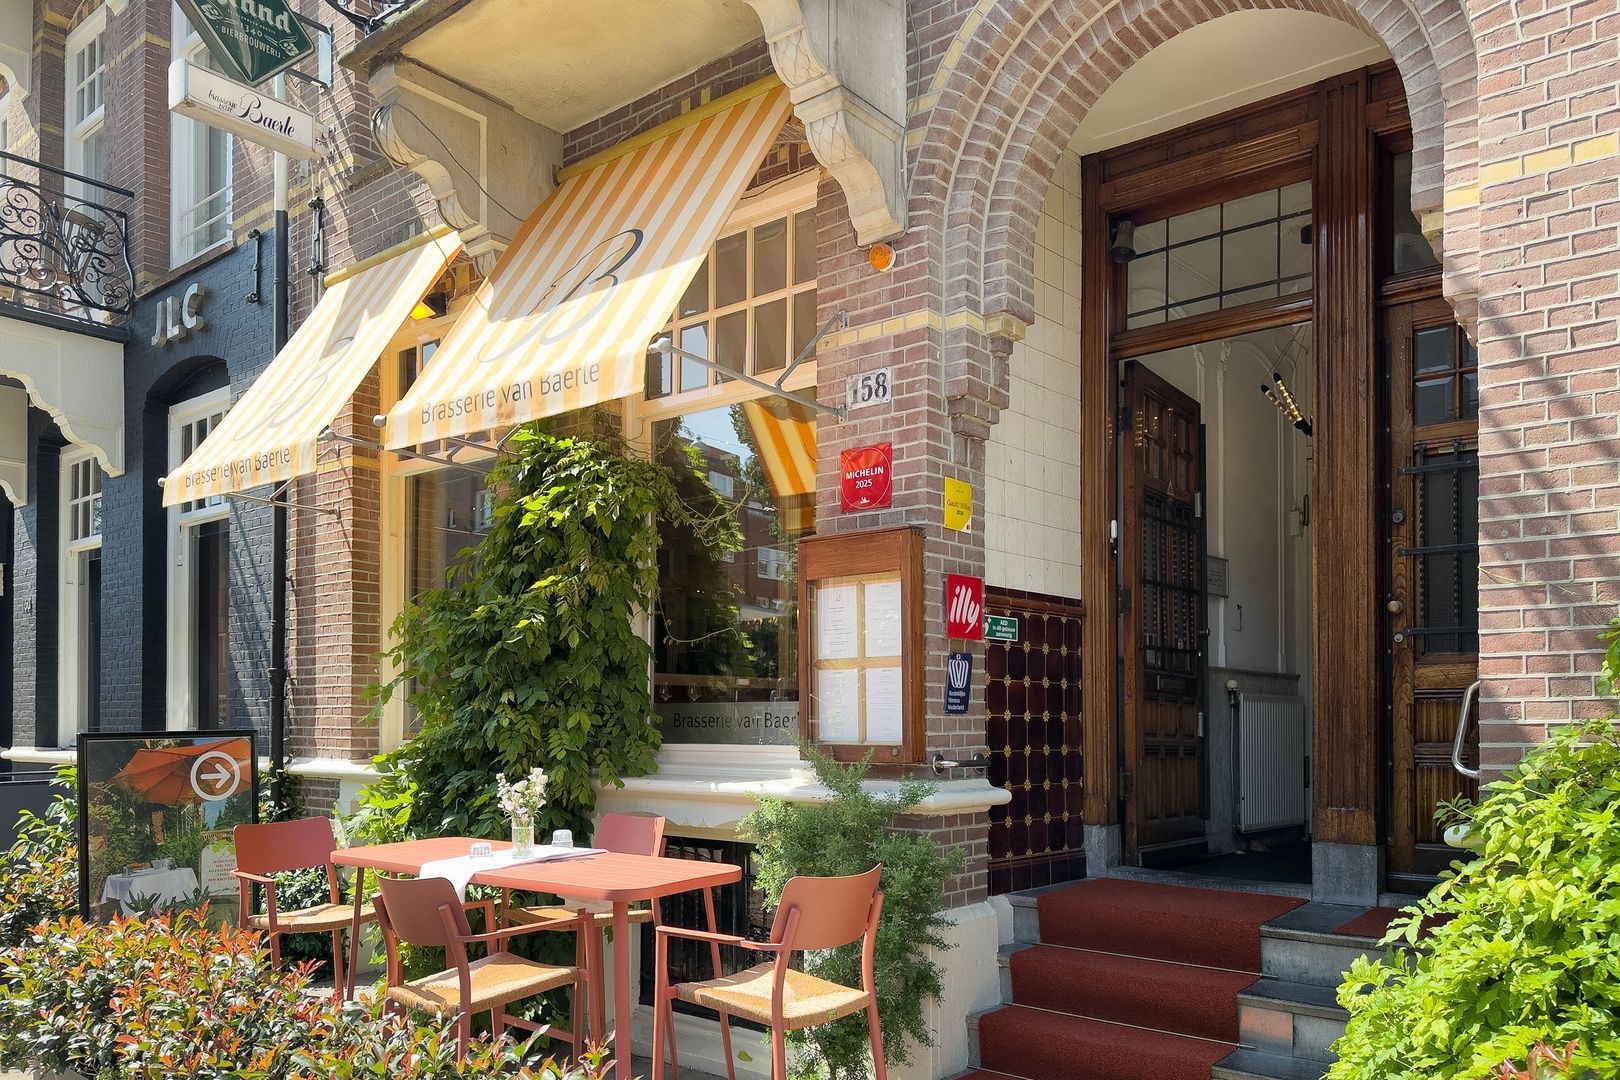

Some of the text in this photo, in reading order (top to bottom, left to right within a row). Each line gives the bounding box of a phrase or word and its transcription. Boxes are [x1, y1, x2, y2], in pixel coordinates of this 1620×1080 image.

[221, 25, 282, 59] BIERBROUWERIJ
[240, 22, 263, 37] 1340
[208, 89, 238, 110] brasserie
[235, 92, 296, 138] Baerle
[151, 282, 206, 347] JLC
[421, 361, 600, 425] Brasserie van Baerle
[850, 372, 888, 405] 158
[185, 445, 291, 489] Brasserie van Baerle
[845, 466, 884, 480] MICHELIN
[855, 478, 873, 489] 2025
[950, 584, 980, 634] illy
[673, 712, 733, 729] Brasserie
[764, 712, 800, 729] Baer
